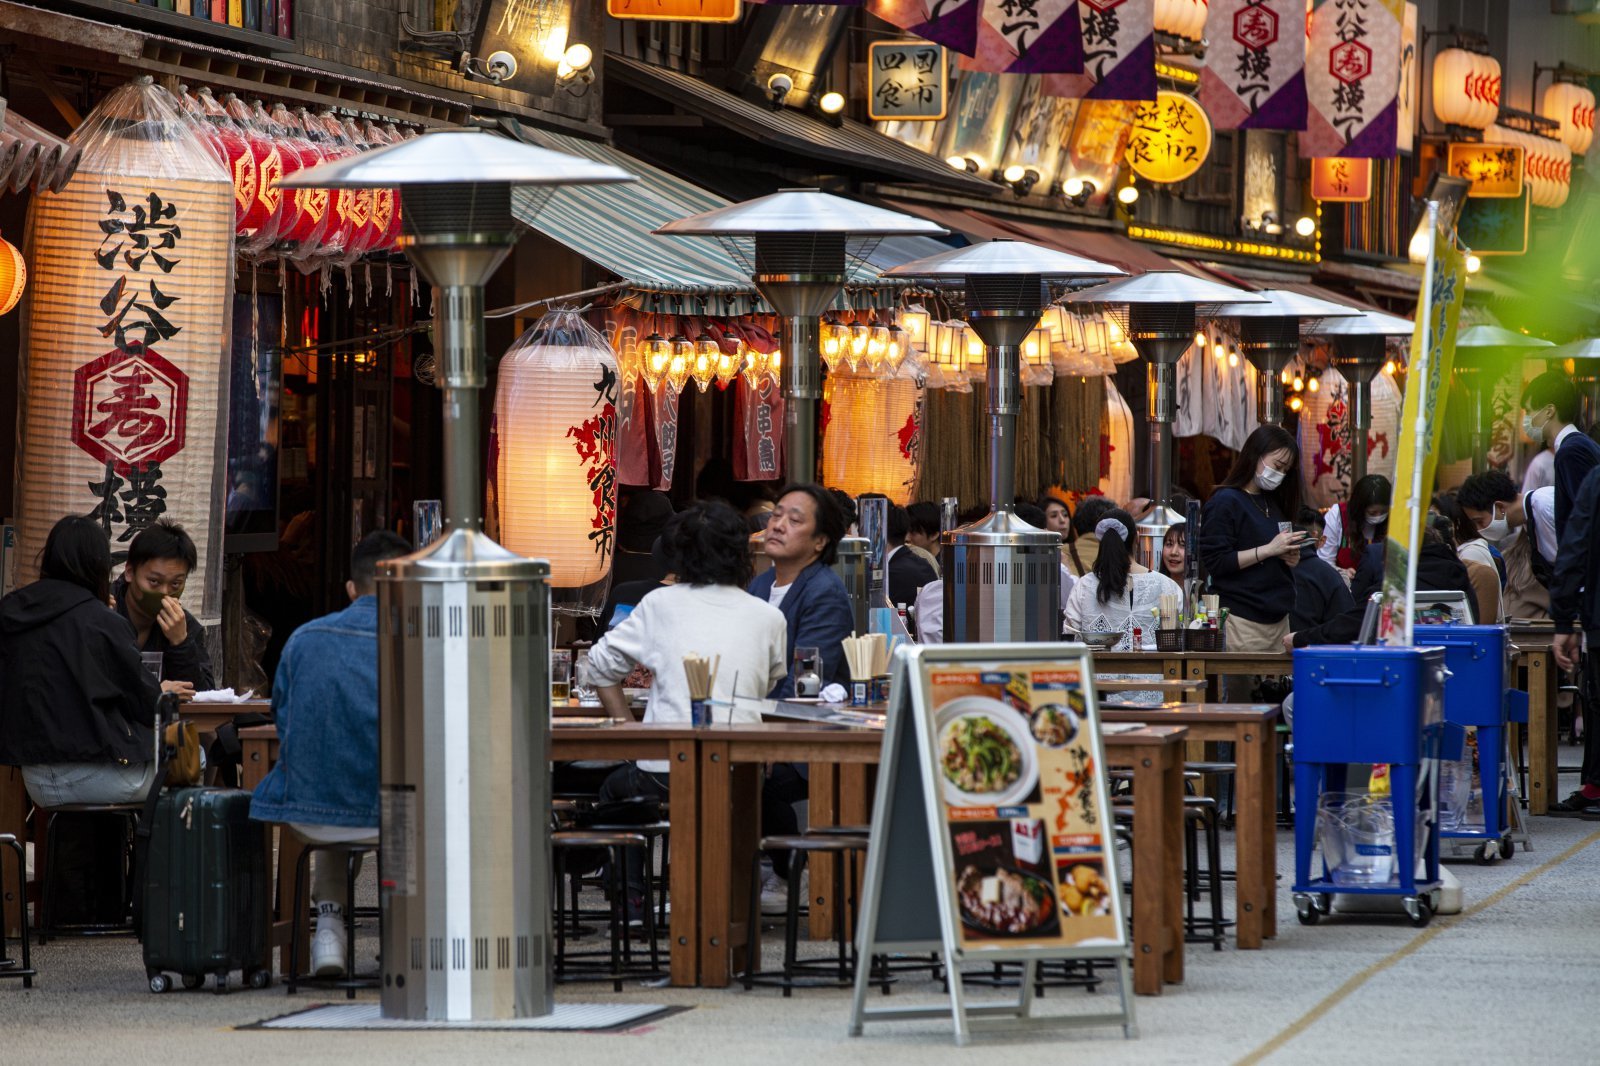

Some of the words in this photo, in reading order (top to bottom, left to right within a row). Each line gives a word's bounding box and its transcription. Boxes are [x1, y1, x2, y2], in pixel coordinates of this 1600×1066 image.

[1082, 9, 1120, 86] 横丁
[1235, 44, 1272, 116] 横丁
[876, 78, 939, 110] 食市
[1331, 78, 1366, 148] 横丁
[588, 362, 618, 571] 九州食市
